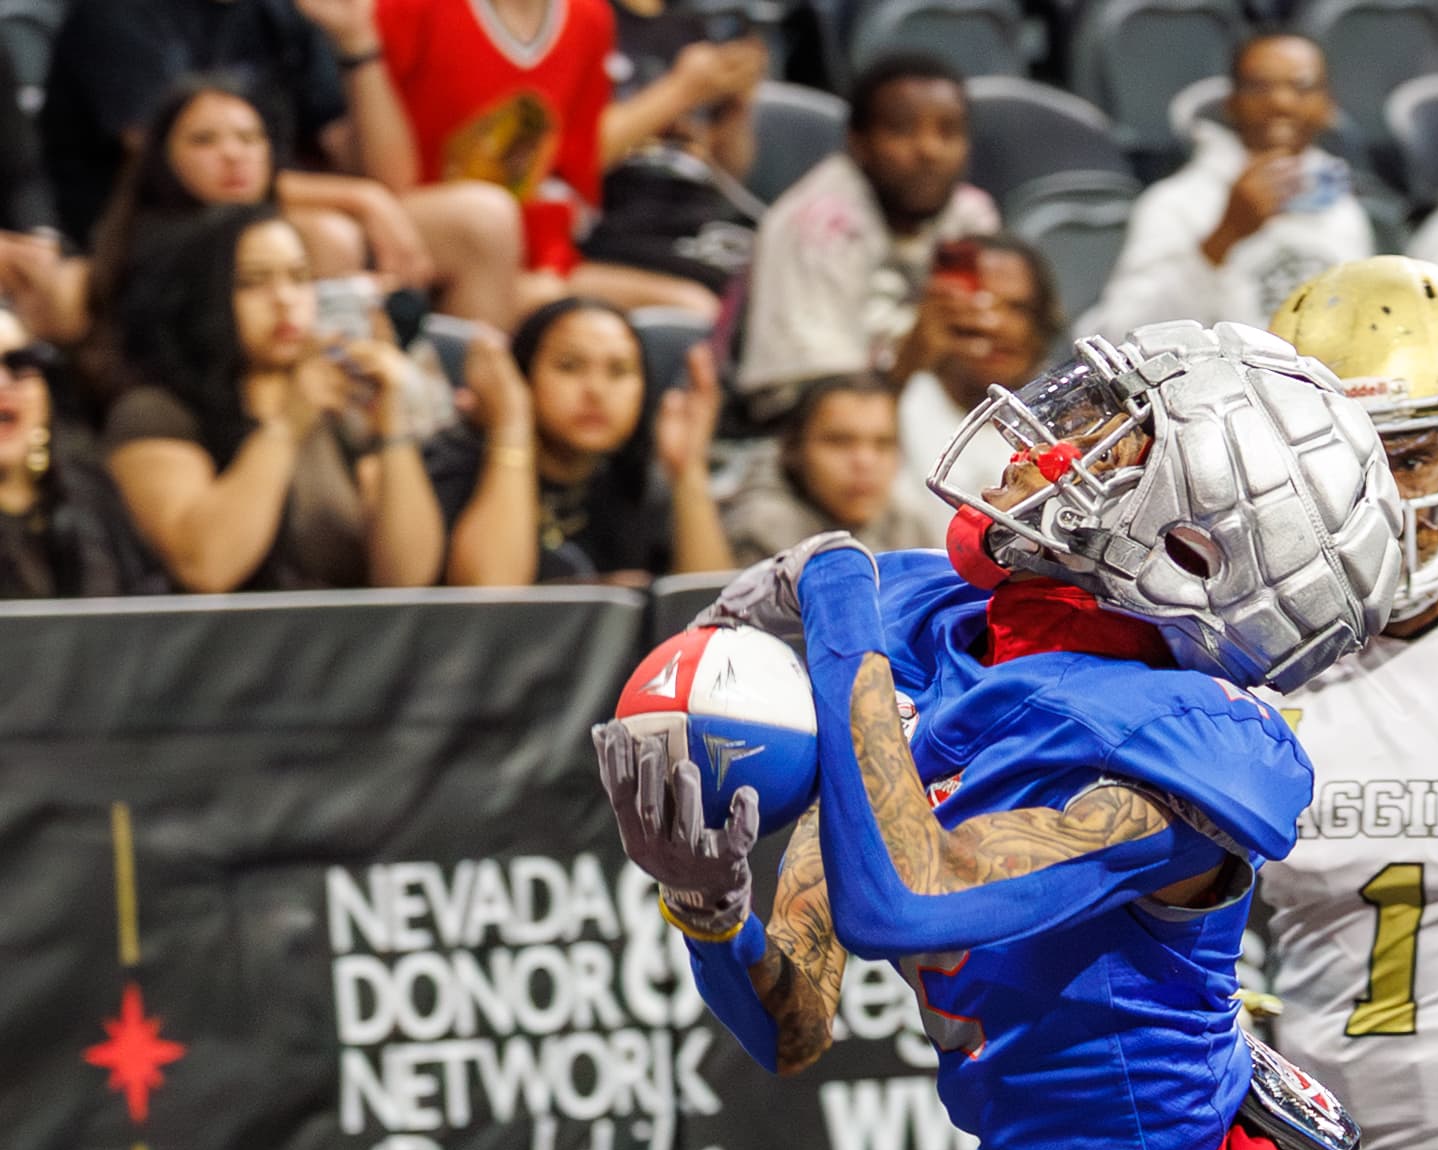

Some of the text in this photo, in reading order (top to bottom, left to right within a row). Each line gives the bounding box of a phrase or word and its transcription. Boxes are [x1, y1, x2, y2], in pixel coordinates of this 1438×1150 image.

[326, 853, 622, 952] NEVADA
[1344, 861, 1426, 1037] 1
[332, 940, 626, 1044] DONOR
[338, 1027, 721, 1134] NETWORK
